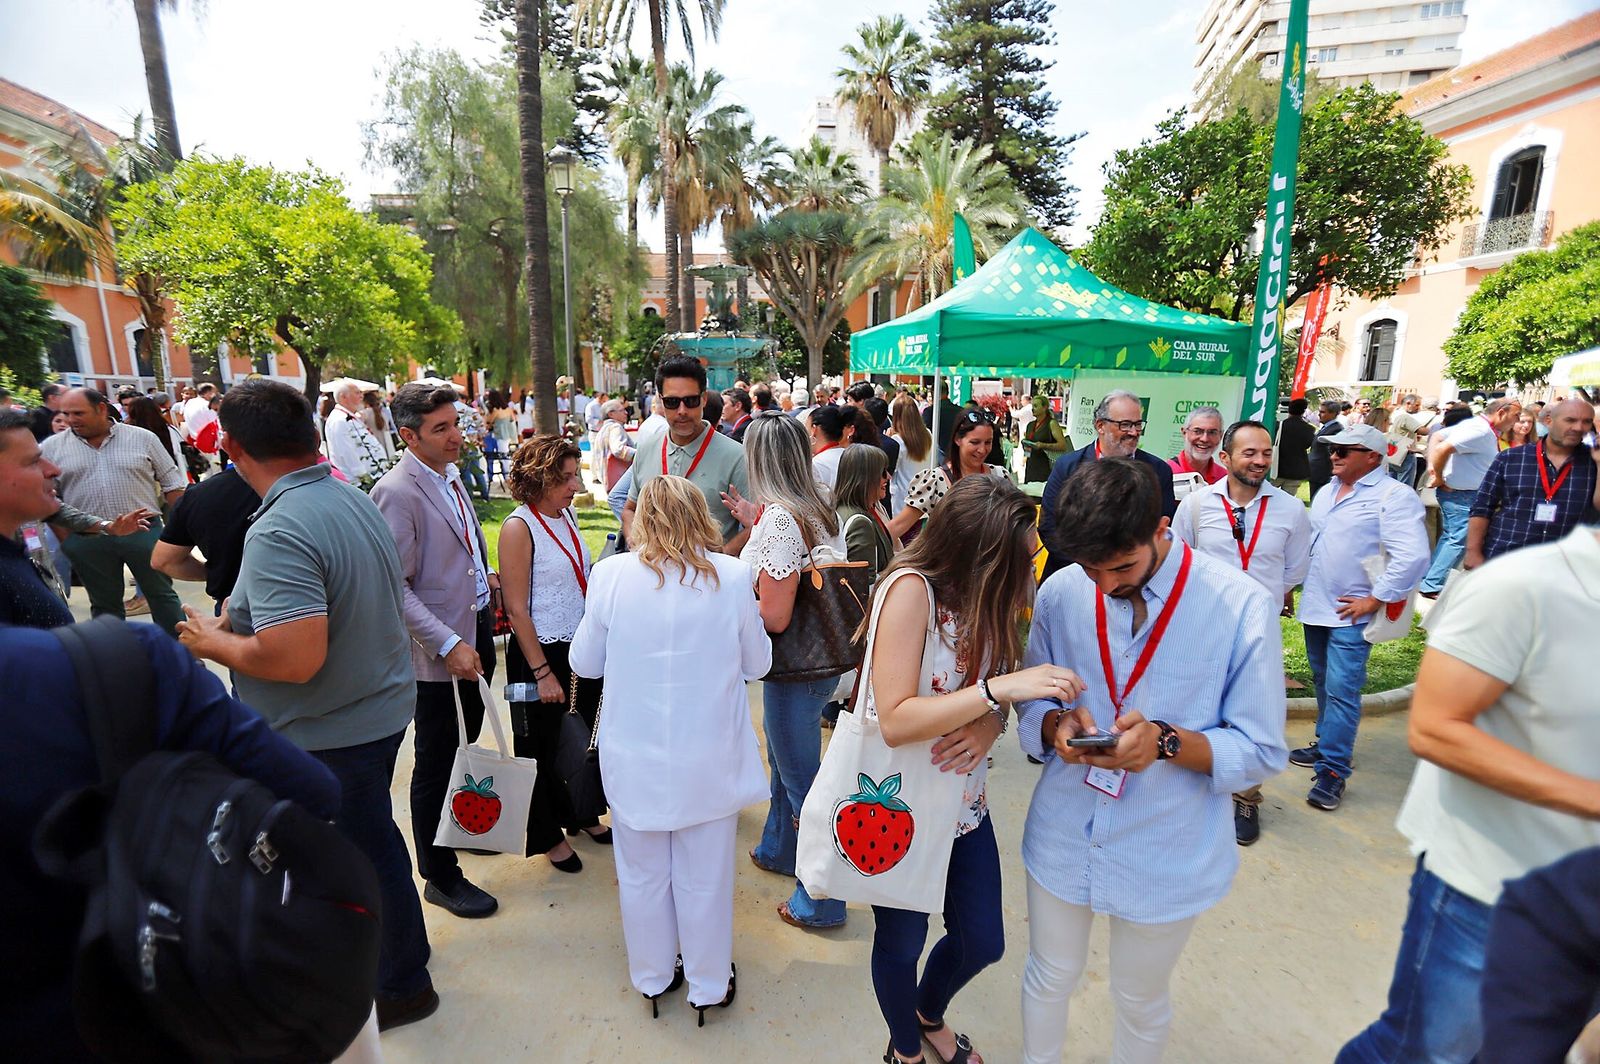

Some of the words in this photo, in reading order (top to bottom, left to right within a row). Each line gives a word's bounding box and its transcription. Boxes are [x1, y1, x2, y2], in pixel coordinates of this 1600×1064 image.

[1173, 340, 1197, 351] CAJA
[1198, 341, 1230, 353] RURAL
[1172, 350, 1193, 361] DEL
[1195, 352, 1216, 362] SUR
